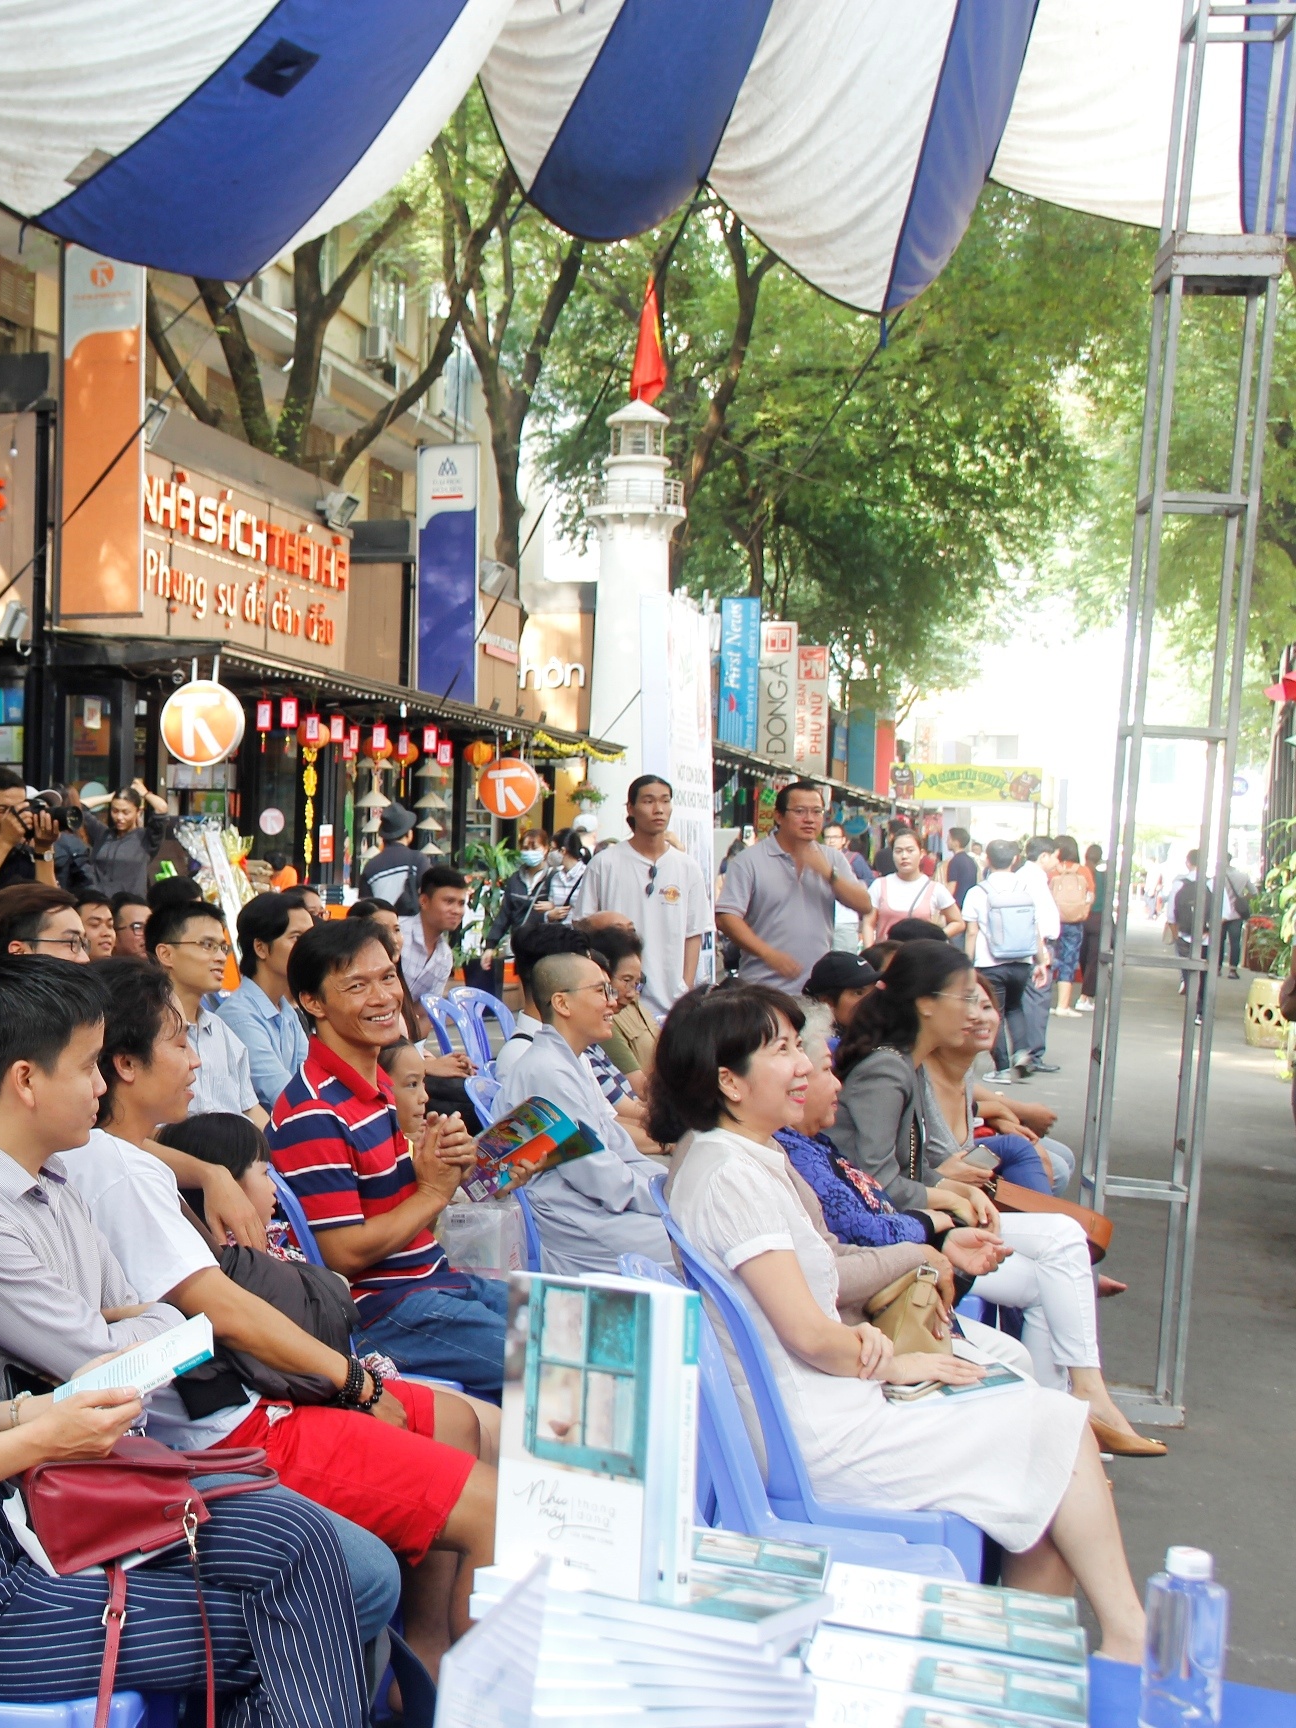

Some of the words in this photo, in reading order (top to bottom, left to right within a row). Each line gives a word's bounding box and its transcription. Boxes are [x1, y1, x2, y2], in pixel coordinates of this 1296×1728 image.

[196, 489, 267, 561] SÁCH
[725, 602, 743, 647] News
[724, 651, 742, 690] First
